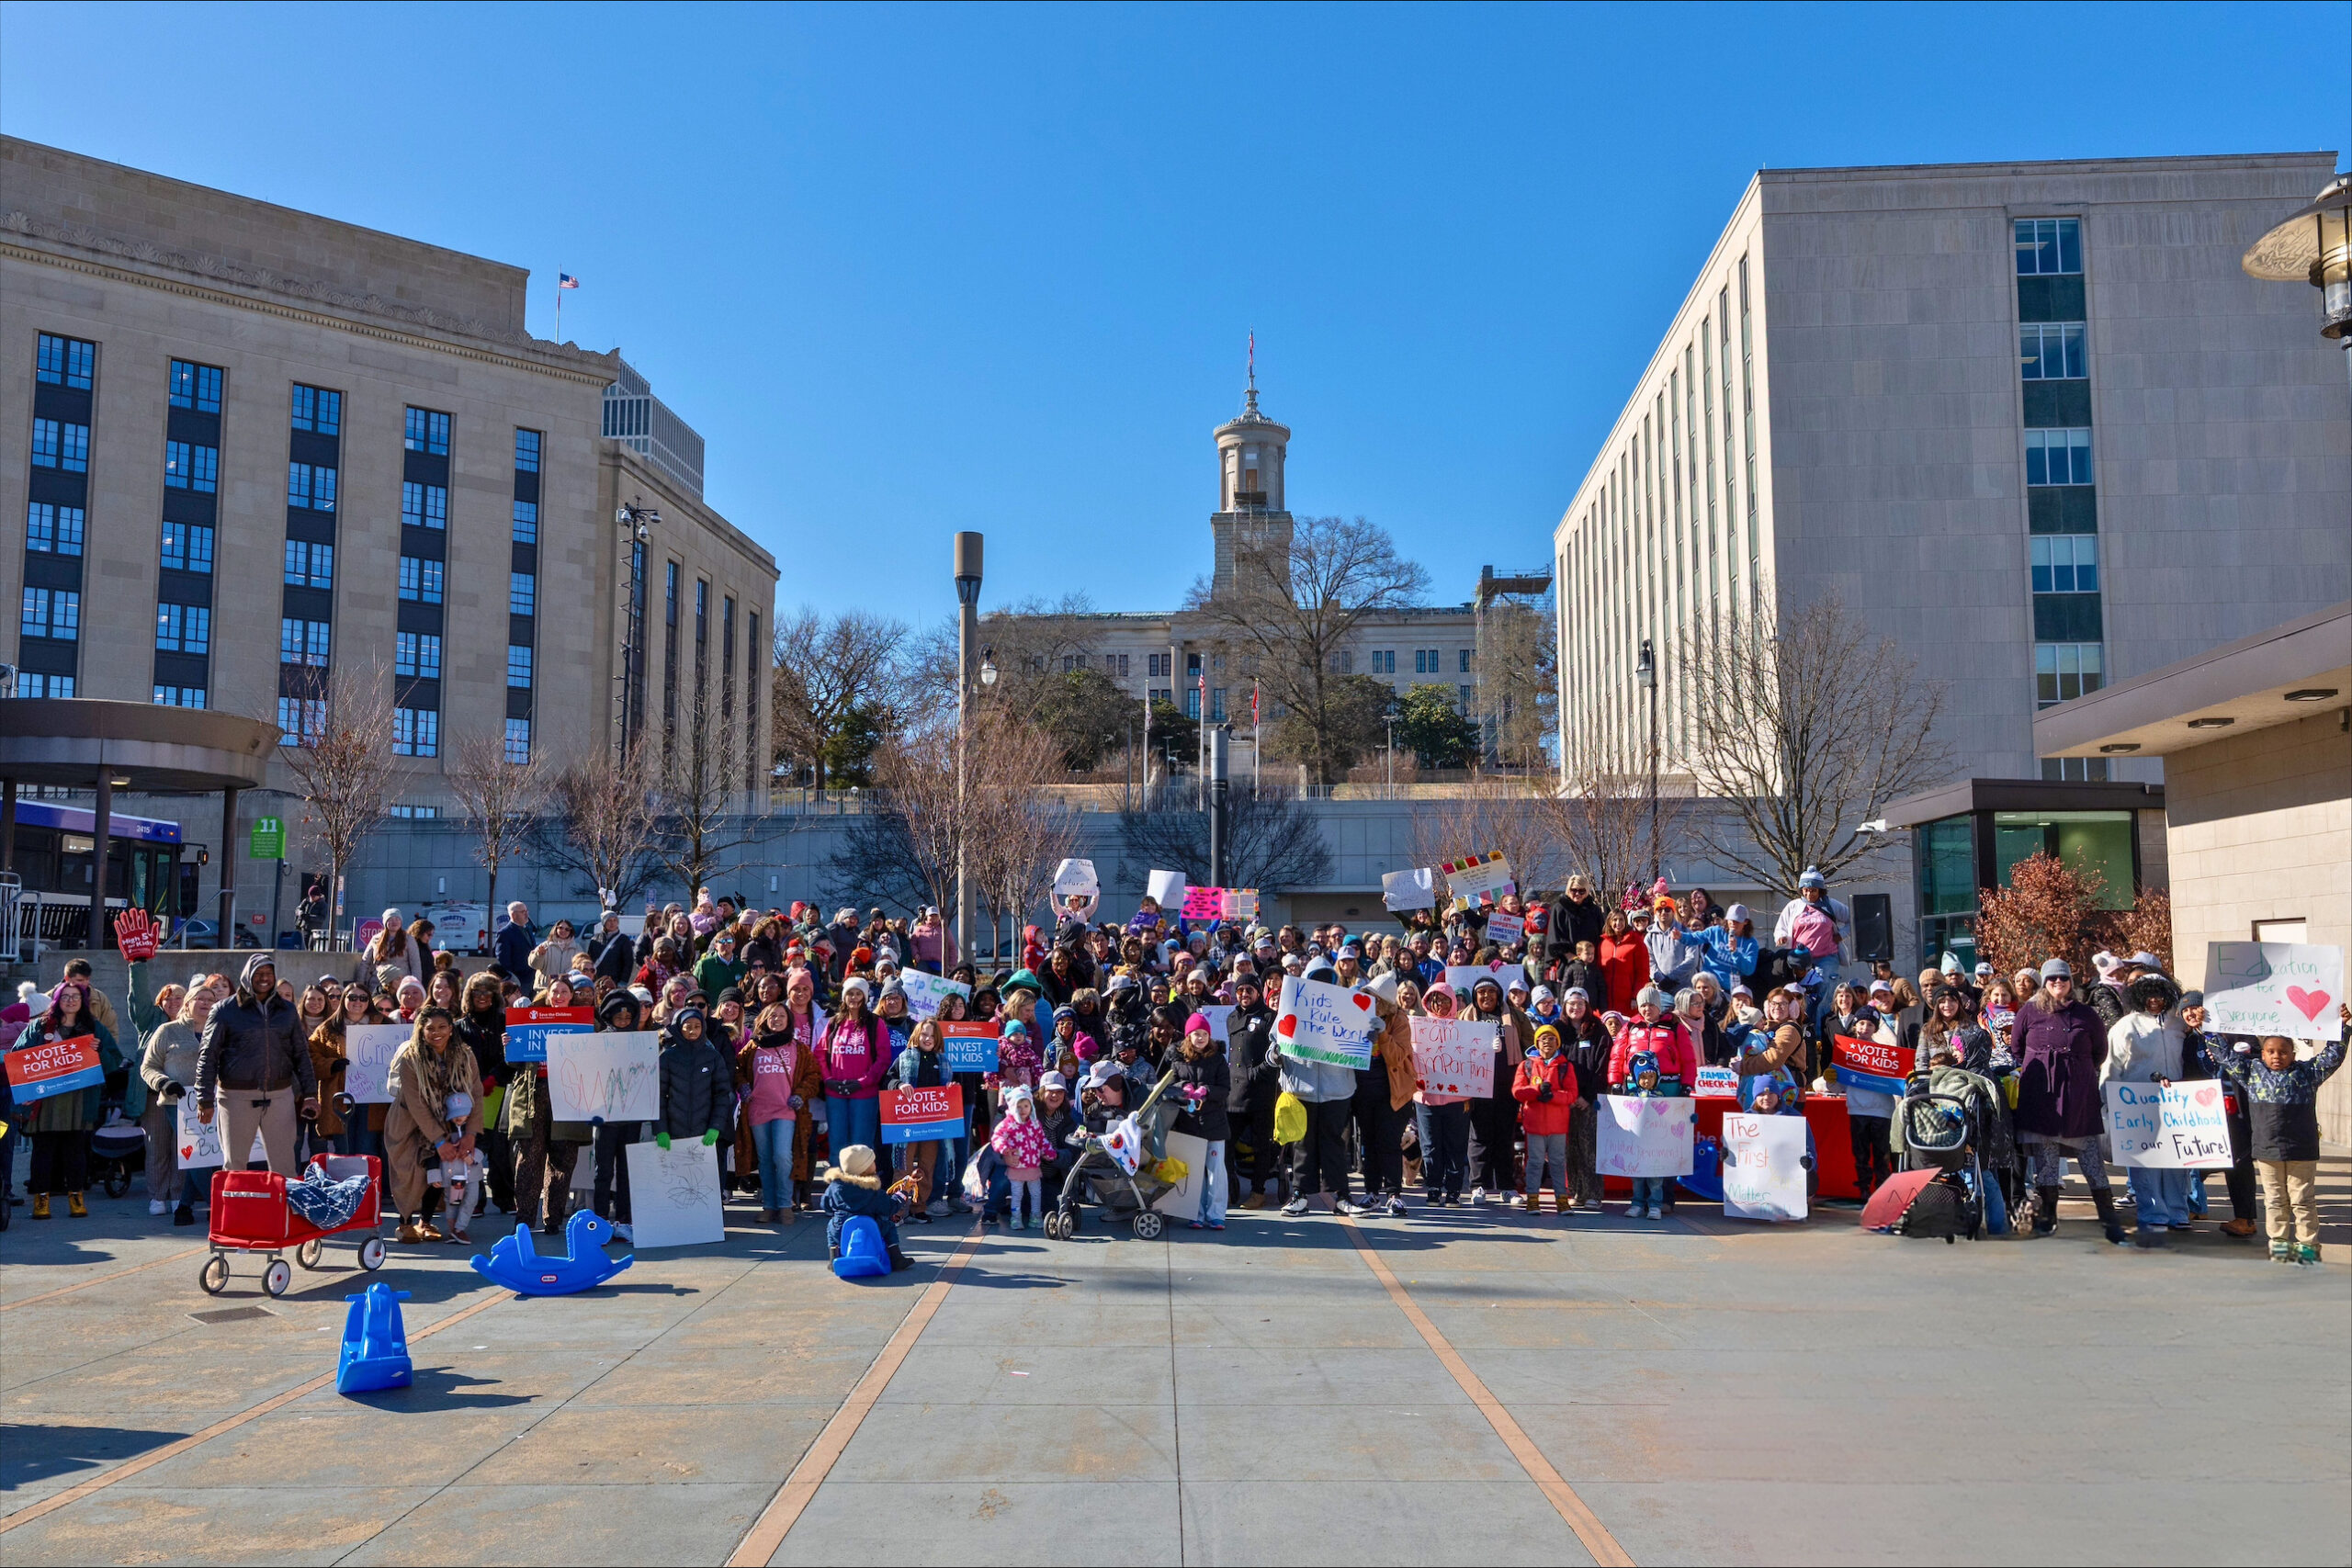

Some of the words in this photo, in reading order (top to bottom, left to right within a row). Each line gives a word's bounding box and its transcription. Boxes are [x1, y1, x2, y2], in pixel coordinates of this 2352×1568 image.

[136, 825, 151, 834] 2415
[261, 819, 277, 832] 11
[141, 932, 149, 941] 5
[2218, 942, 2317, 977] Education
[2256, 979, 2276, 993] for
[1295, 982, 1332, 1008] Kids
[1310, 1008, 1341, 1024] Rule
[2214, 1001, 2280, 1027] Everyone
[1301, 1020, 1328, 1035] The
[1411, 1022, 1422, 1043] I
[1430, 1025, 1459, 1043] am
[527, 1041, 541, 1051] IN
[835, 1035, 848, 1043] TN
[889, 1039, 908, 1047] R&R
[32, 1044, 68, 1060] VOTE
[833, 1045, 865, 1055] CCR&R
[948, 1042, 982, 1052] INVEST
[1857, 1043, 1889, 1058] VOTE
[23, 1060, 51, 1074] FOR
[53, 1052, 84, 1067] KIDS
[757, 1055, 772, 1065] TN
[948, 1053, 958, 1062] IN
[961, 1053, 984, 1063] KIDS
[1846, 1051, 1869, 1065] FOR
[1871, 1057, 1899, 1070] KIDS
[757, 1066, 791, 1075] CCR&R
[1700, 1071, 1732, 1080] FAMILY
[1698, 1079, 1738, 1089] CHECK-IN
[2119, 1086, 2188, 1109] Quality
[895, 1104, 919, 1115] FOR
[922, 1101, 949, 1112] KIDS
[1726, 1116, 1760, 1138] The
[2114, 1111, 2154, 1132] Early
[2163, 1110, 2222, 1128] Childhood
[2141, 1141, 2163, 1151] our
[2173, 1134, 2232, 1159] Future!
[1737, 1141, 1770, 1168] First
[1727, 1183, 1771, 1202] Matter
